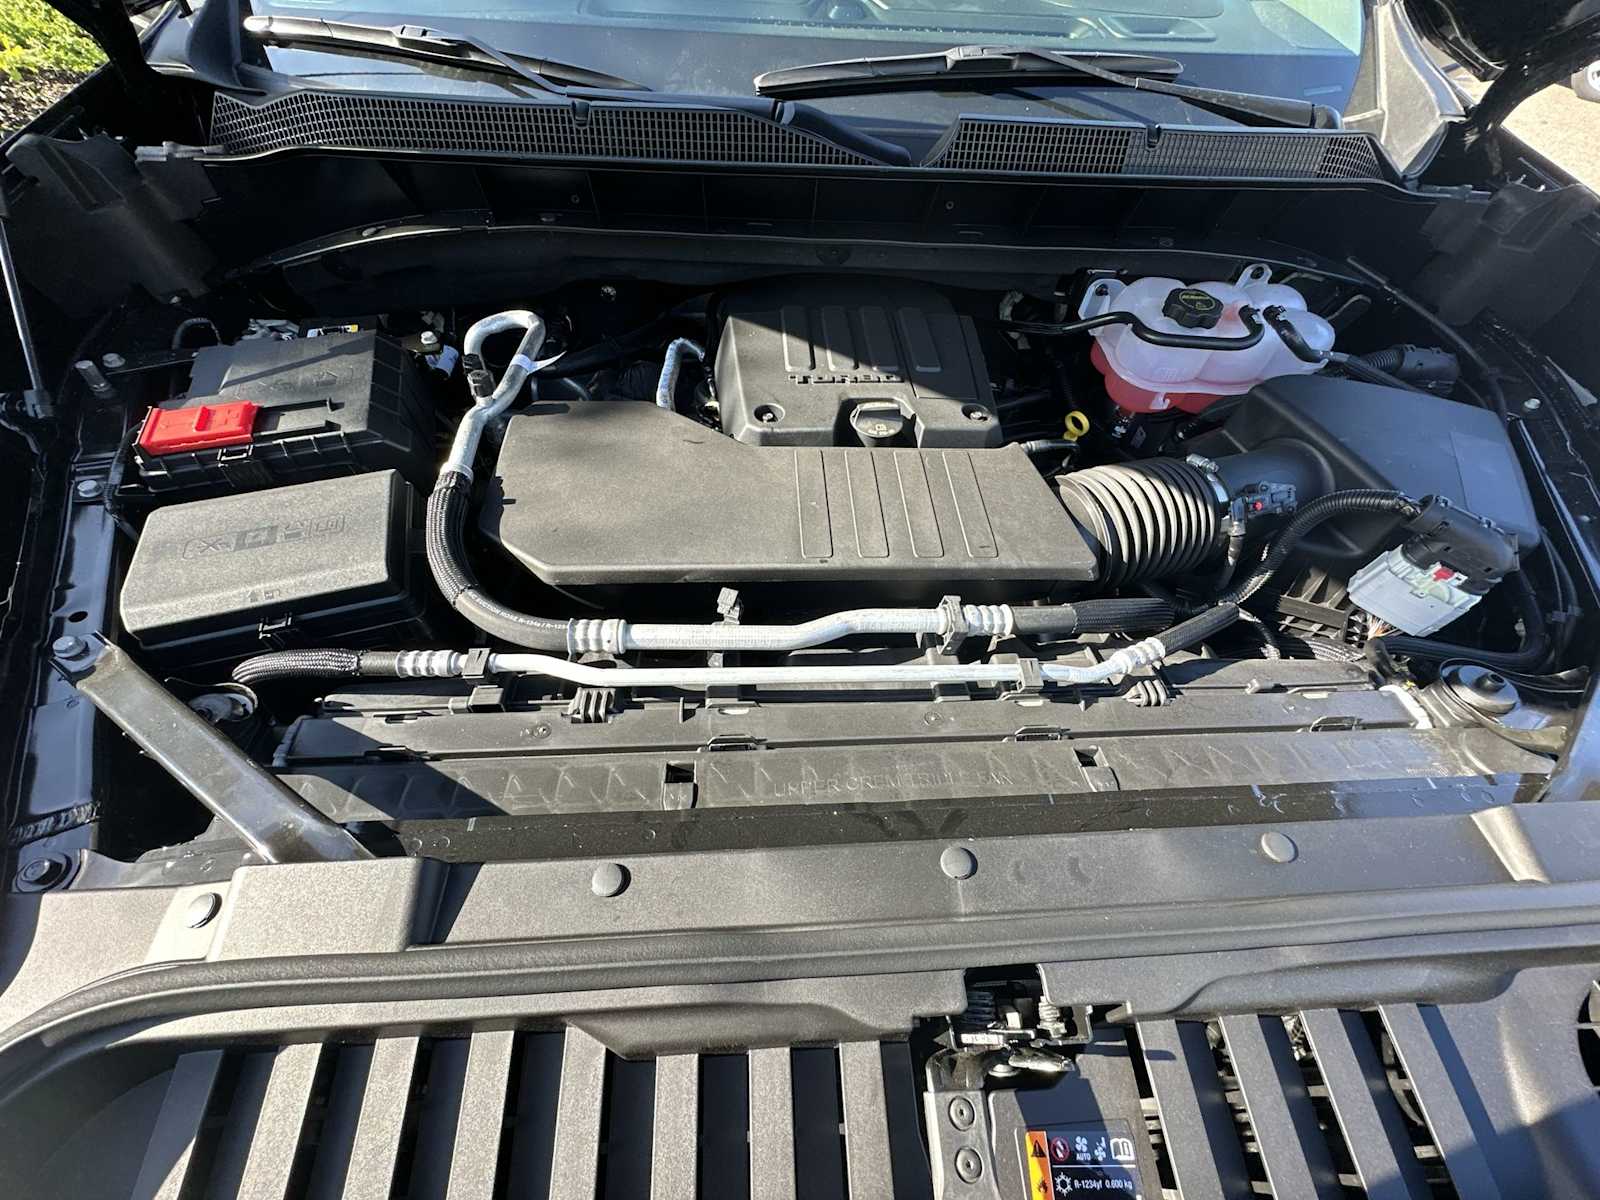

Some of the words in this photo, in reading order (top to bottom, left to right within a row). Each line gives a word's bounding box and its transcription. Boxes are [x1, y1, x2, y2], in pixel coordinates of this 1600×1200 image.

[1076, 1153, 1091, 1161] AUTO
[1074, 1179, 1102, 1190] R-1234yf
[1124, 1179, 1133, 1190] kg
